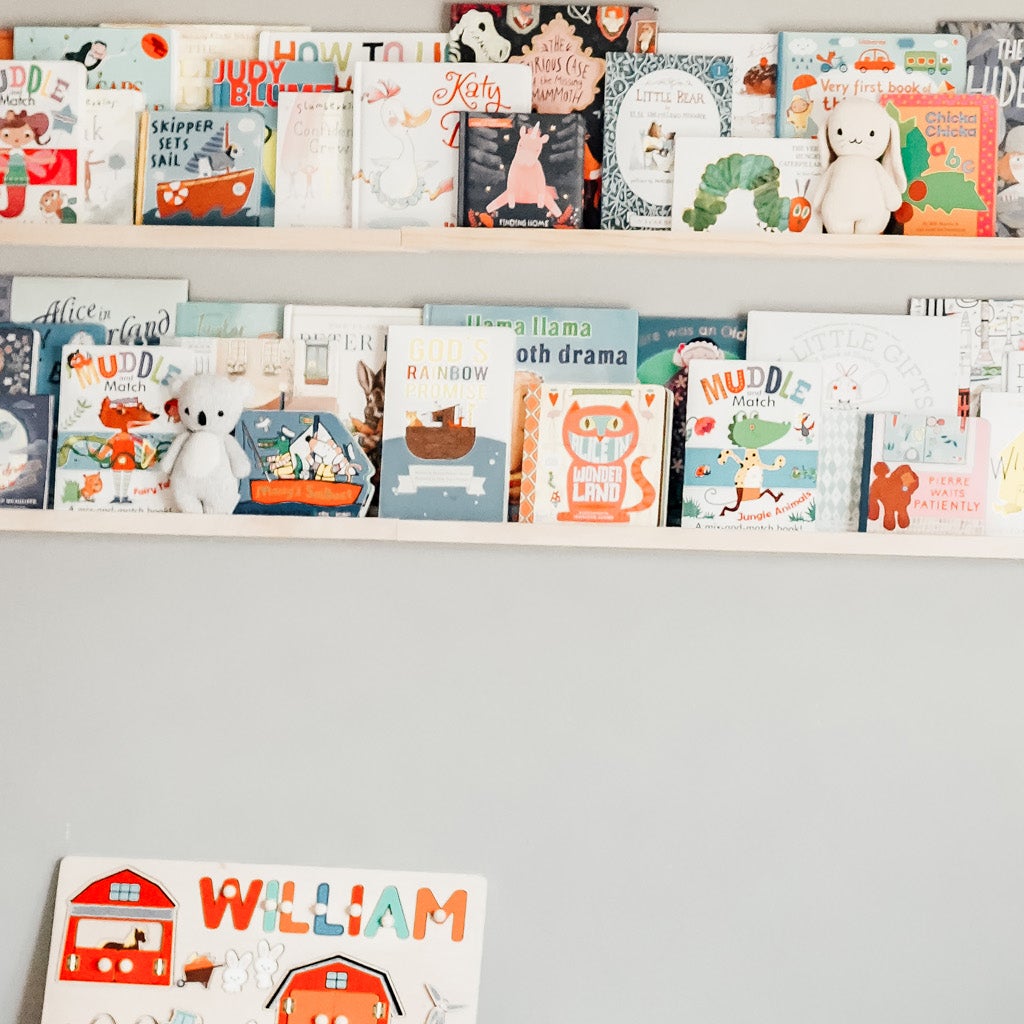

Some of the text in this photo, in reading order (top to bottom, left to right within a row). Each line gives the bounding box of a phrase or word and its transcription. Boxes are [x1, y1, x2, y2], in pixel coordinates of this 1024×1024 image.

[996, 37, 1024, 60] THE
[213, 59, 287, 84] JUDY
[531, 55, 590, 79] RIOUS CASE
[0, 64, 70, 103] DDLE
[432, 71, 511, 113] Katy
[820, 78, 849, 95] Very
[853, 79, 884, 96] first
[887, 79, 920, 93] book
[636, 89, 706, 104] LITTLE BEAR
[151, 117, 213, 134] SKIPPER
[925, 111, 977, 124] Chicka
[925, 125, 977, 137] Chicka
[159, 137, 189, 150] SETS
[151, 152, 181, 168] SAIL
[32, 296, 111, 324] Alice in
[106, 309, 171, 346] rland
[532, 316, 592, 337] llama
[666, 326, 694, 339] was
[699, 325, 717, 336] an
[720, 325, 747, 342] Old
[409, 336, 489, 364] GOD'S
[515, 343, 628, 366] oth drama
[406, 365, 489, 381] RAINBOW
[790, 329, 878, 362] LITTLE
[883, 344, 934, 410] GIFTS
[104, 381, 147, 392] Match
[405, 382, 487, 400] PROMISE
[700, 365, 812, 406] MUDDLE
[732, 395, 776, 407] Match
[572, 465, 622, 483] WONDER
[928, 476, 970, 487] PIERRE
[572, 482, 620, 503] LAND
[930, 488, 966, 498] WAITS
[738, 490, 812, 522] Jungle Animals
[914, 500, 981, 512] PATIENTLY
[198, 876, 469, 943] WILLIAM
